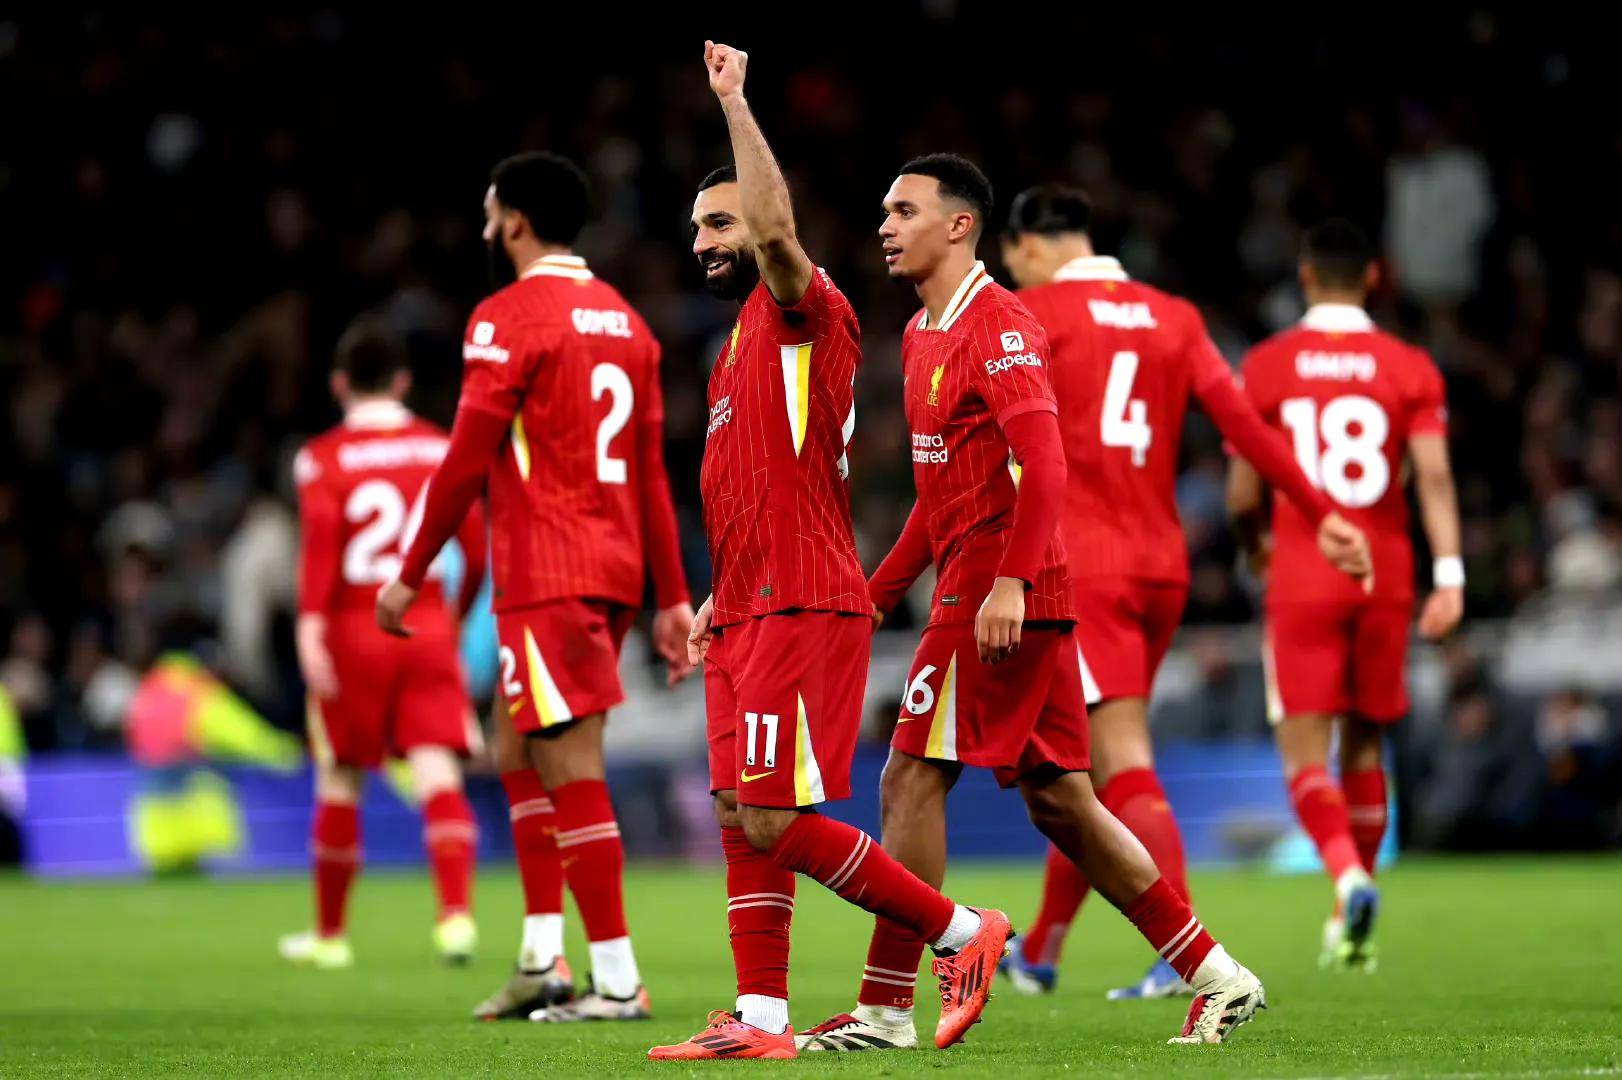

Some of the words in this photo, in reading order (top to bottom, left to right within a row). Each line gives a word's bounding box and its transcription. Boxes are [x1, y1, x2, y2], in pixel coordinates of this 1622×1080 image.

[571, 307, 633, 338] GOMEZ
[591, 362, 634, 484] 2
[1101, 350, 1152, 467] 4
[1279, 394, 1390, 508] 18
[342, 476, 434, 586] 2
[498, 645, 523, 696] 2
[901, 664, 937, 715] 6
[744, 711, 779, 768] 11
